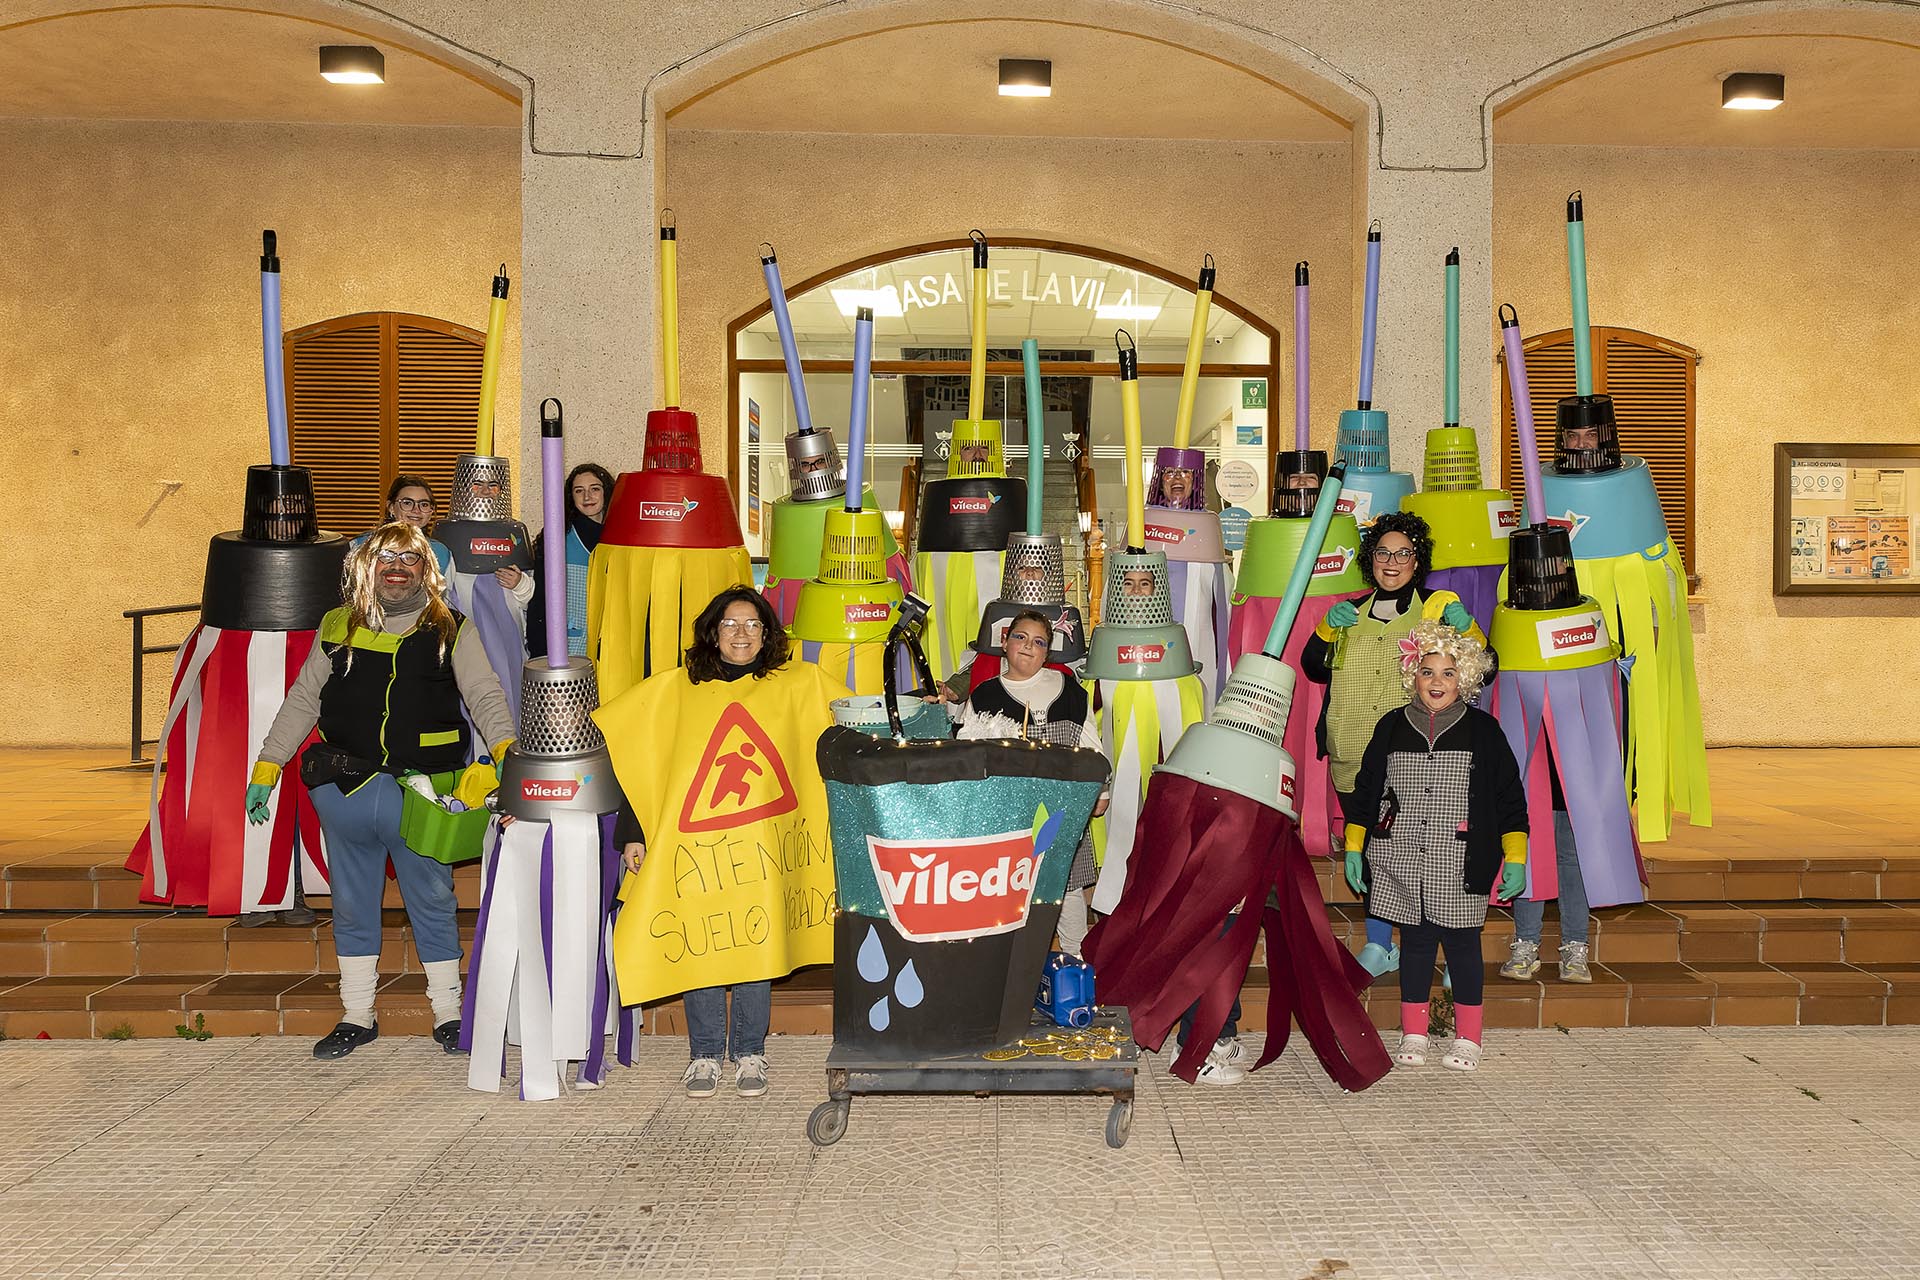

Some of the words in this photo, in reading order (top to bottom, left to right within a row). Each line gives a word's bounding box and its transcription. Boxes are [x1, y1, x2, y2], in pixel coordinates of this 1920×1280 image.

[1022, 270, 1061, 304] LA
[644, 506, 681, 517] vileda
[952, 501, 987, 511] vileda
[1145, 528, 1179, 541] vileda
[474, 541, 511, 552] vileda
[1314, 561, 1341, 571] ileda
[848, 607, 887, 619] vileda
[1556, 632, 1594, 645] vileda
[1120, 649, 1160, 660] vileda
[524, 783, 572, 797] vileda
[674, 818, 831, 899] ATENCIÓN
[881, 852, 1032, 905] vileda
[650, 905, 770, 963] SUELO
